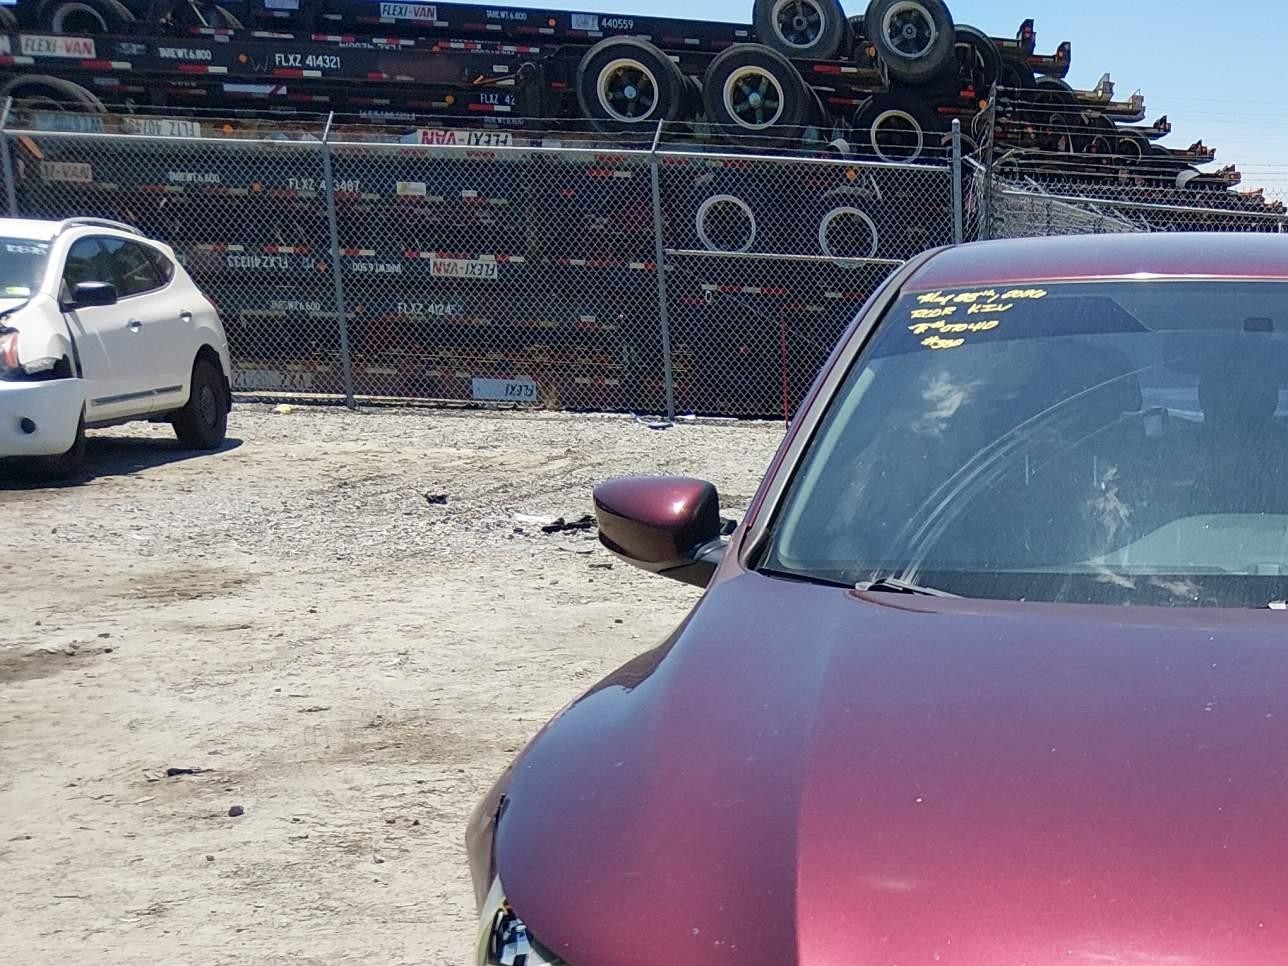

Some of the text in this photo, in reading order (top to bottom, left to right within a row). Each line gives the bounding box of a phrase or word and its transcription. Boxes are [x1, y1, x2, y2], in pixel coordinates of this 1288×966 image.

[382, 4, 435, 18] FLEXI-VAN
[601, 17, 634, 30] 440559
[25, 38, 93, 56] FLEXI-VAN
[275, 53, 341, 69] FLXZ 414321
[432, 260, 496, 277] FLEXI-VAN
